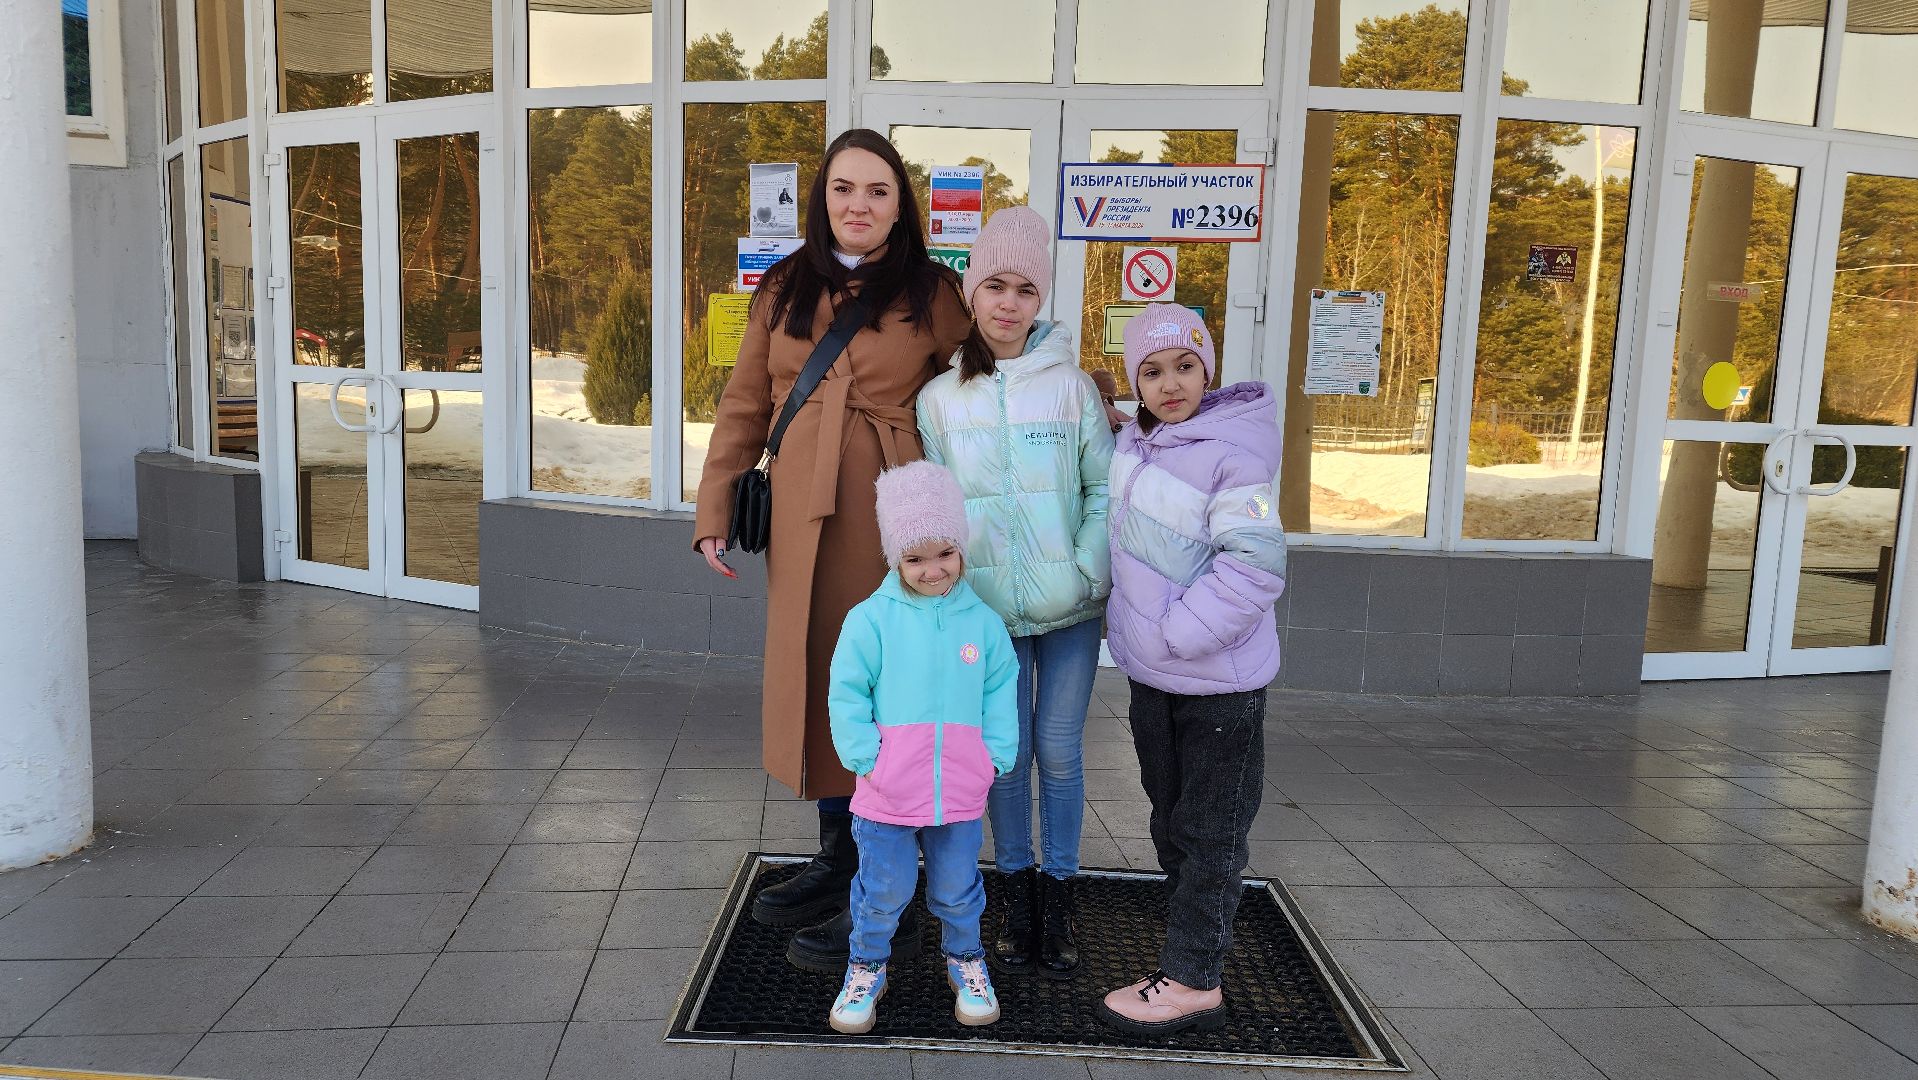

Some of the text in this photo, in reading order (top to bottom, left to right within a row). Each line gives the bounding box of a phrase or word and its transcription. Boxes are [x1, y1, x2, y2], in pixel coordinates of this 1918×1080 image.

[1070, 173, 1255, 188] ИЗБИРАТЕЛЬНЫЙ УЧАСТОК
[1106, 205, 1152, 213] ПРЕЗИДЕНТА
[1102, 213, 1132, 221] РОССИИ
[1720, 286, 1749, 299] ВХОД
